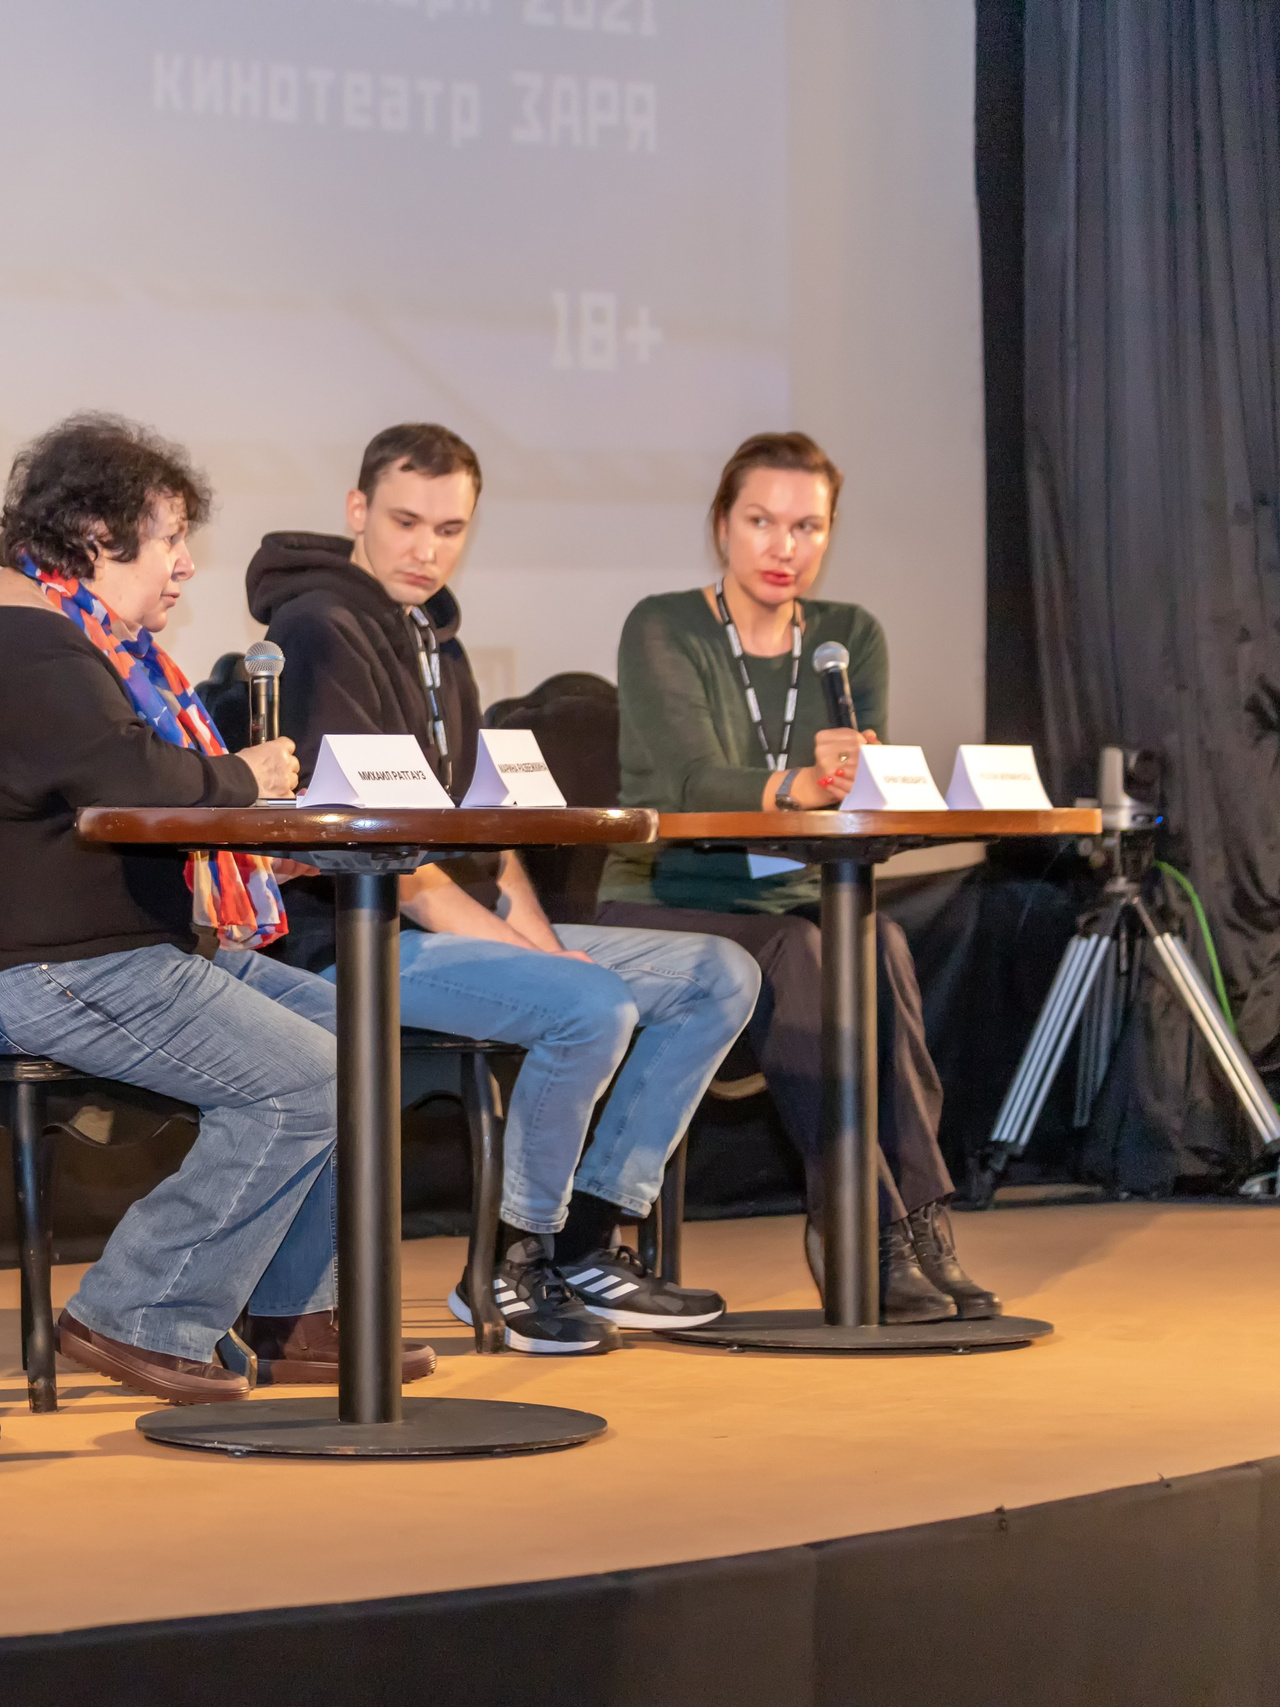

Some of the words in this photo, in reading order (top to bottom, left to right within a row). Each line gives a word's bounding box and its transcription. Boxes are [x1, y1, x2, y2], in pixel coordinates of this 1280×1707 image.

[511, 69, 658, 154] ЗАРЯ
[551, 290, 664, 371] 18+
[358, 770, 393, 781] МИХАИЛ
[391, 770, 427, 781] РАТГАУЗ
